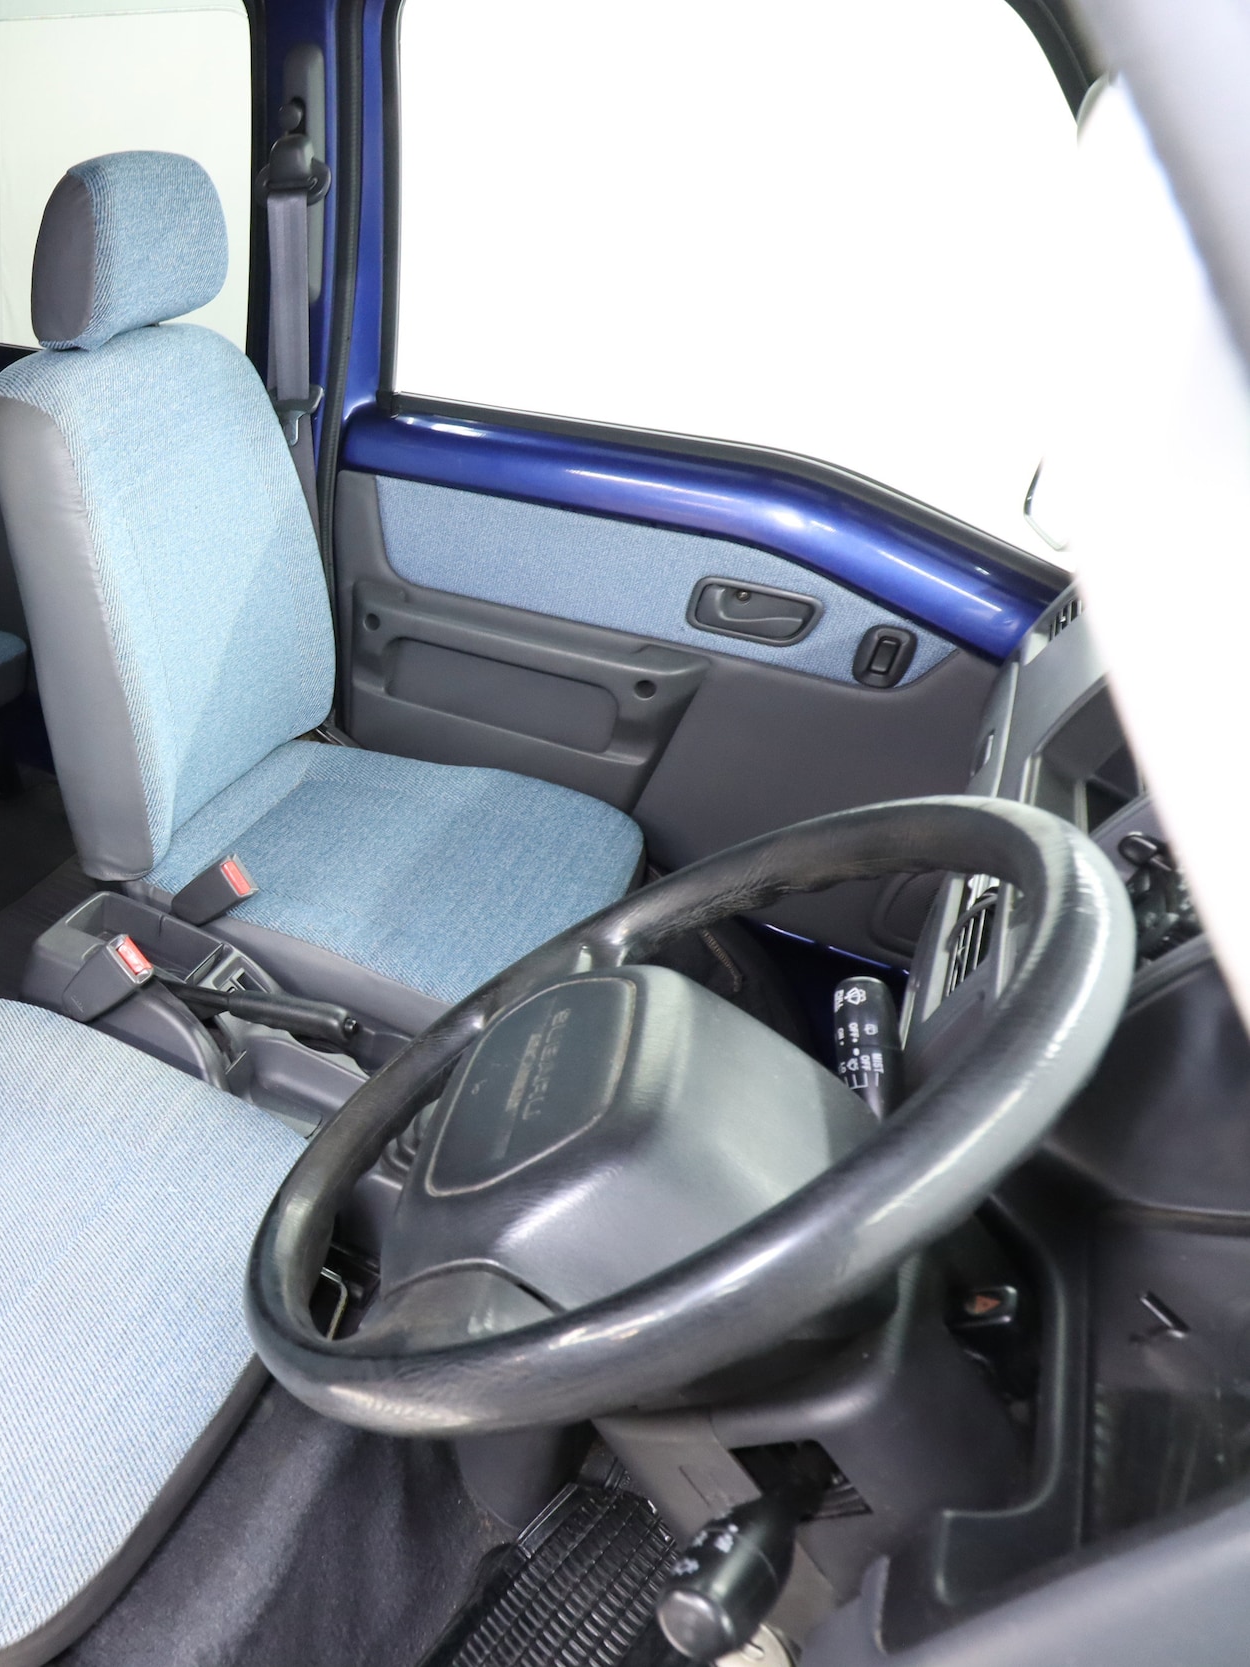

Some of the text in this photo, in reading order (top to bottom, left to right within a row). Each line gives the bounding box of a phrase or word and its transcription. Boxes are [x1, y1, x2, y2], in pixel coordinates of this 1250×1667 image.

[848, 1022, 860, 1038] OFF
[860, 1055, 872, 1071] OFF
[871, 1052, 885, 1074] MIST
